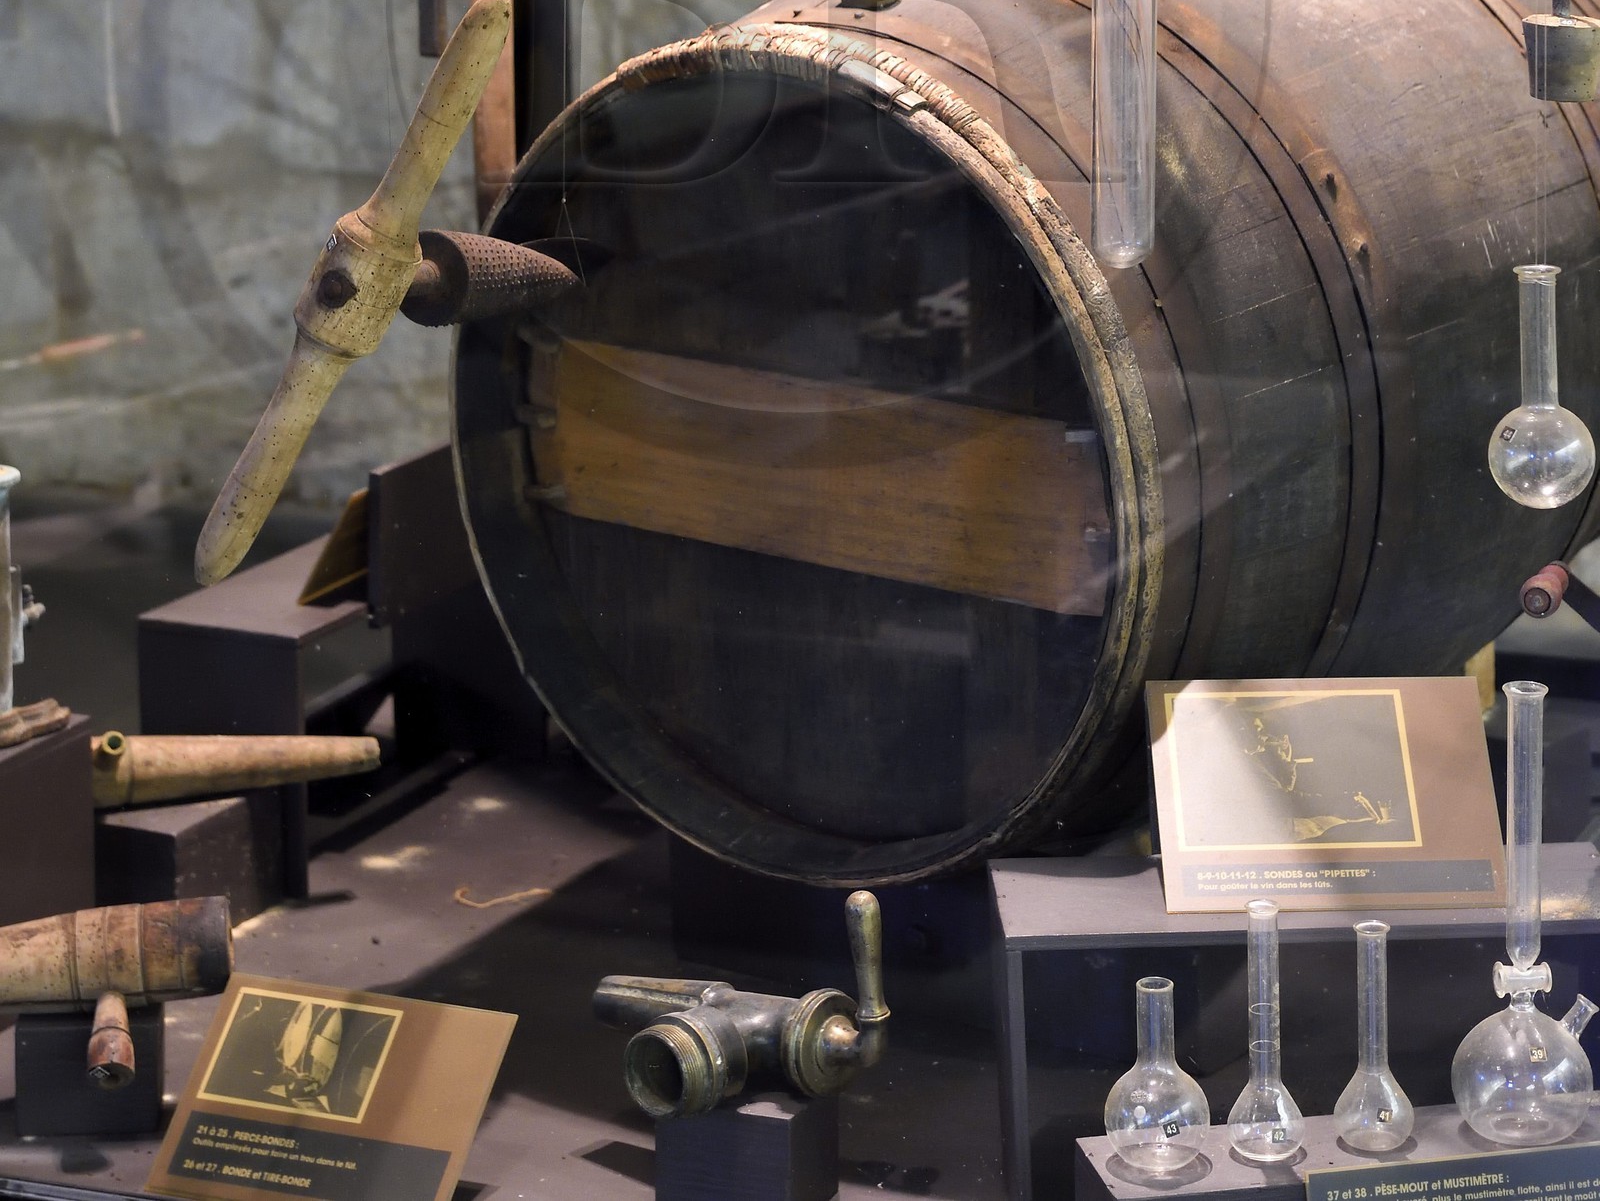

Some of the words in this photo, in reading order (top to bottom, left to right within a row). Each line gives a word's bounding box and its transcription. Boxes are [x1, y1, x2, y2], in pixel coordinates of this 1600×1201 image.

[1197, 871, 1257, 880] 8-9-10-11-12
[1263, 870, 1303, 879] SONDES
[1198, 883, 1218, 891] Pour
[1220, 882, 1248, 892] goûter
[1276, 881, 1298, 889] dans
[1314, 880, 1333, 888] fûts.
[1532, 1049, 1543, 1059] 39
[1379, 1110, 1389, 1120] 41
[1166, 1123, 1177, 1134] 43
[196, 1125, 208, 1134] 21
[209, 1126, 216, 1136] à
[233, 1131, 295, 1148] PERCE-BONDES
[1274, 1130, 1284, 1140] 42
[251, 1147, 270, 1156] pour
[316, 1157, 335, 1166] dans
[336, 1160, 344, 1168] le
[195, 1162, 205, 1171] et
[205, 1163, 217, 1172] 27
[222, 1165, 252, 1178] BONDE
[252, 1171, 262, 1180] et
[262, 1171, 312, 1188] TIRE-BONDE
[1327, 1190, 1339, 1201] 37
[1342, 1189, 1352, 1199] et
[1355, 1187, 1367, 1198] 38
[1374, 1181, 1429, 1196] PÈSE-MOUT
[1431, 1180, 1441, 1190] et
[1443, 1173, 1504, 1189] MUSTIMÈTRE
[1464, 1187, 1515, 1200] mustimètre
[1517, 1185, 1543, 1196] flotte,
[1545, 1182, 1567, 1192] ainsi
[1569, 1181, 1575, 1189] il
[1577, 1179, 1591, 1189] est
[1574, 1191, 1597, 1200] moût
